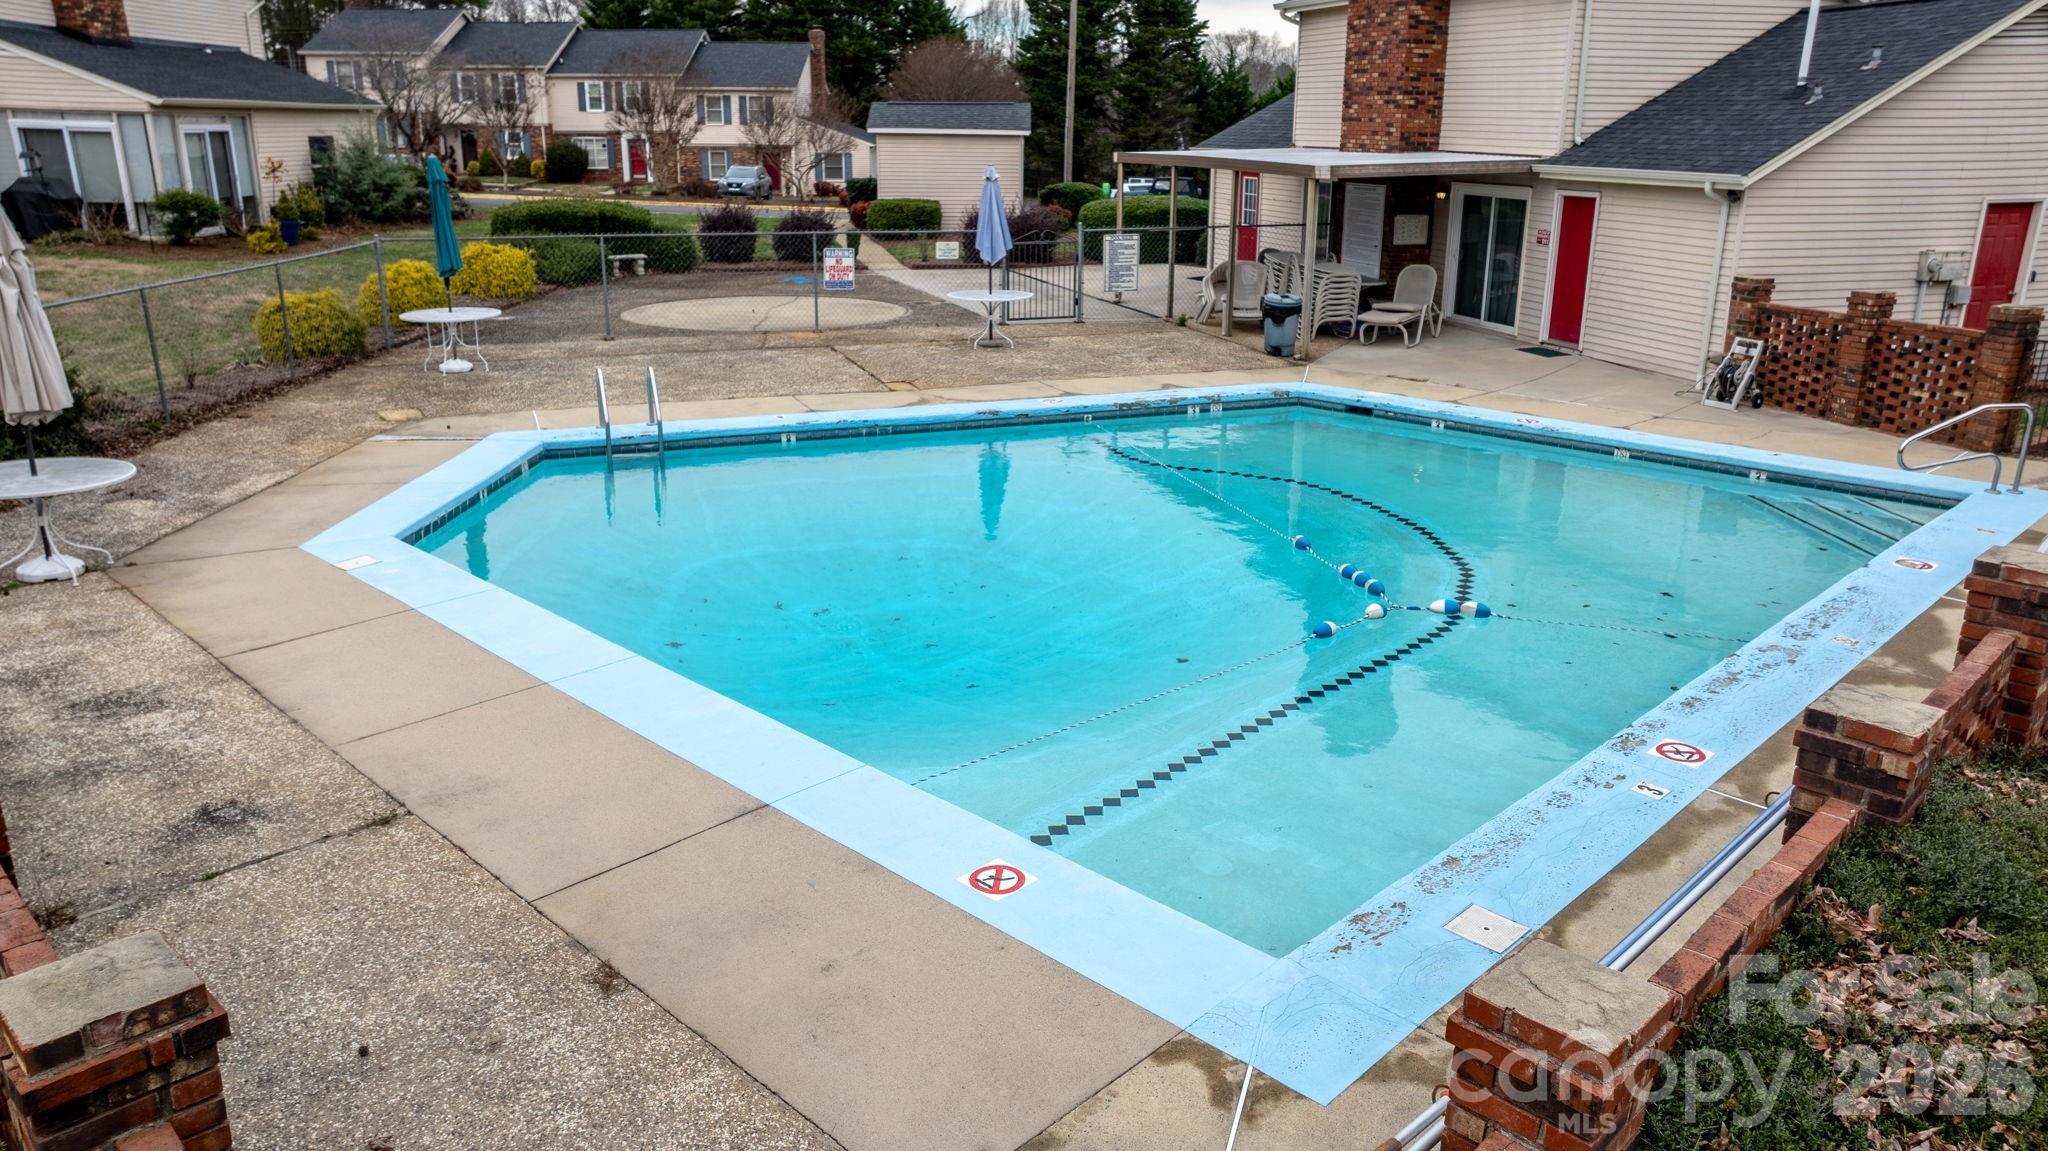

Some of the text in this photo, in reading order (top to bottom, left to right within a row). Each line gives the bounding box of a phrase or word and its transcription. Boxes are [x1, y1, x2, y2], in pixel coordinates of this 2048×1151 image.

[825, 249, 853, 258] WARNING
[825, 265, 852, 273] LIFEGUARD
[828, 272, 849, 280] ON DUTY
[1637, 784, 1664, 795] 3
